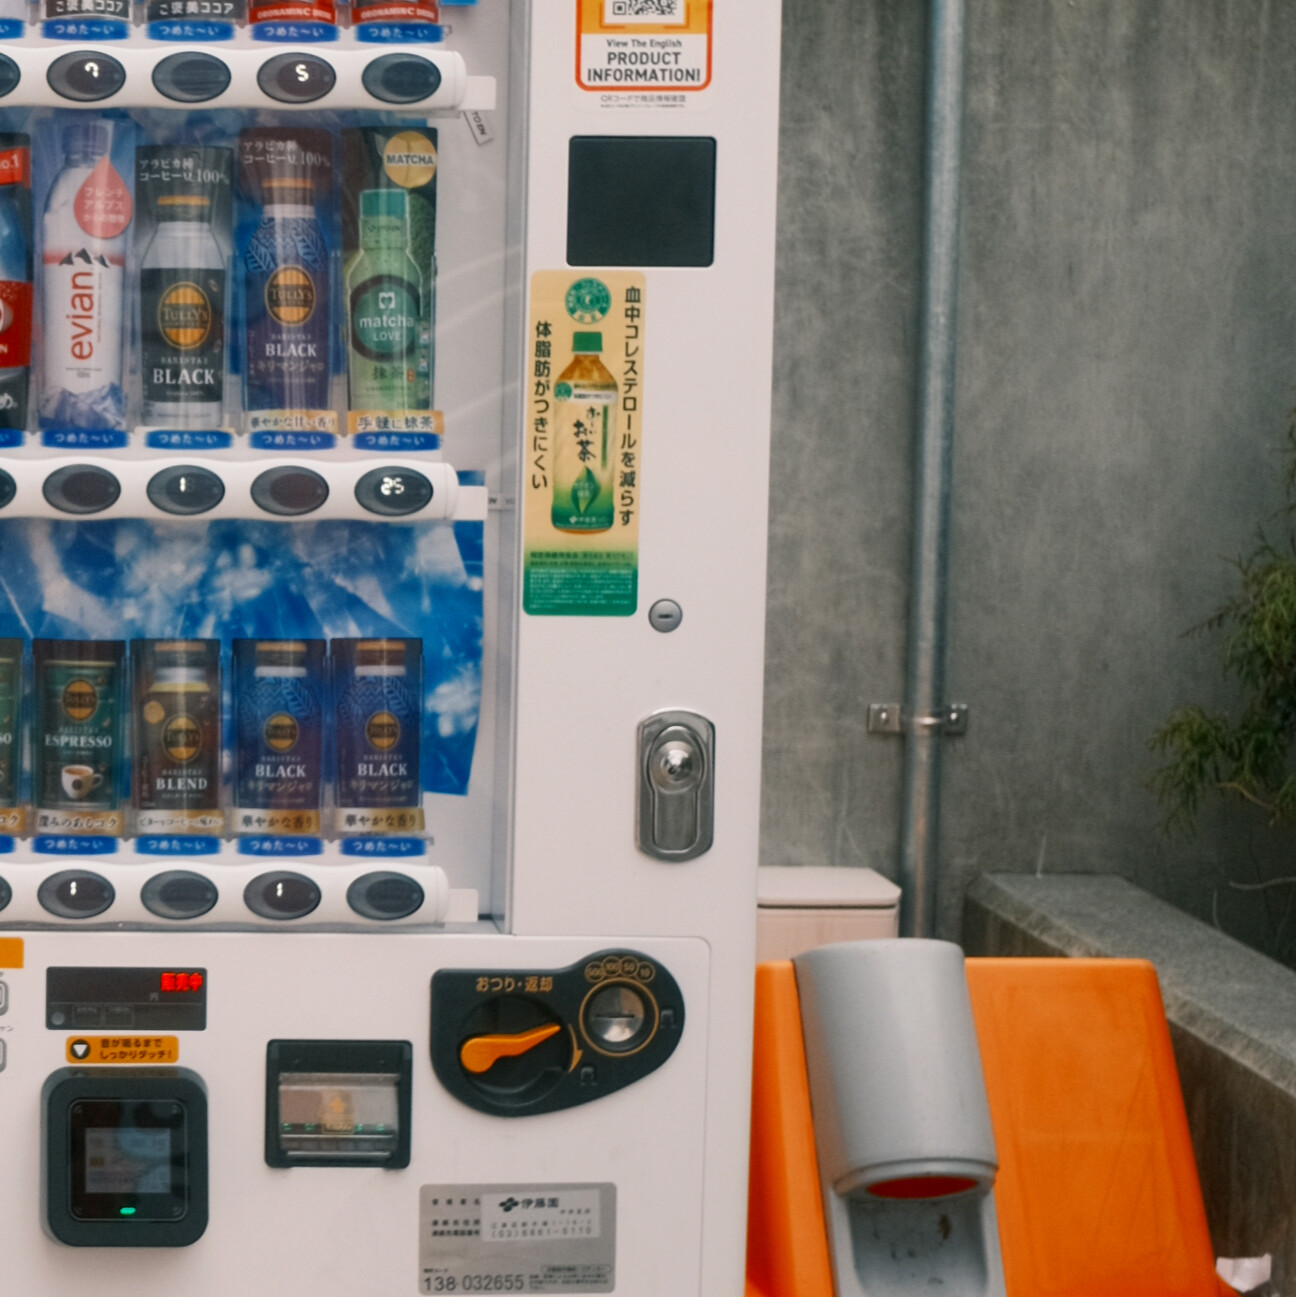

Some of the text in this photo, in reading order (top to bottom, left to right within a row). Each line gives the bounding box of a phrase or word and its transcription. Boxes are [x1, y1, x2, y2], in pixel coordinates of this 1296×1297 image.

[650, 39, 682, 49] English
[607, 52, 681, 65] PRODUCT
[588, 68, 700, 82] INFORMATION!
[386, 155, 434, 165] MATCHA
[66, 269, 93, 360] evian
[360, 315, 414, 328] matcha
[373, 332, 402, 341] LOVE
[265, 344, 317, 357] BLACK
[153, 369, 214, 385] BLACK
[532, 320, 552, 489] 体脂肪がつきにくい
[619, 286, 641, 526] 血中コレステロールを減らす
[45, 735, 112, 747] ESPRESSO
[255, 765, 306, 778] BLACK
[357, 763, 407, 776] BLACK
[156, 778, 208, 791] BLEND
[476, 976, 553, 992] おつり・返却
[521, 1198, 559, 1208] 伊藤園
